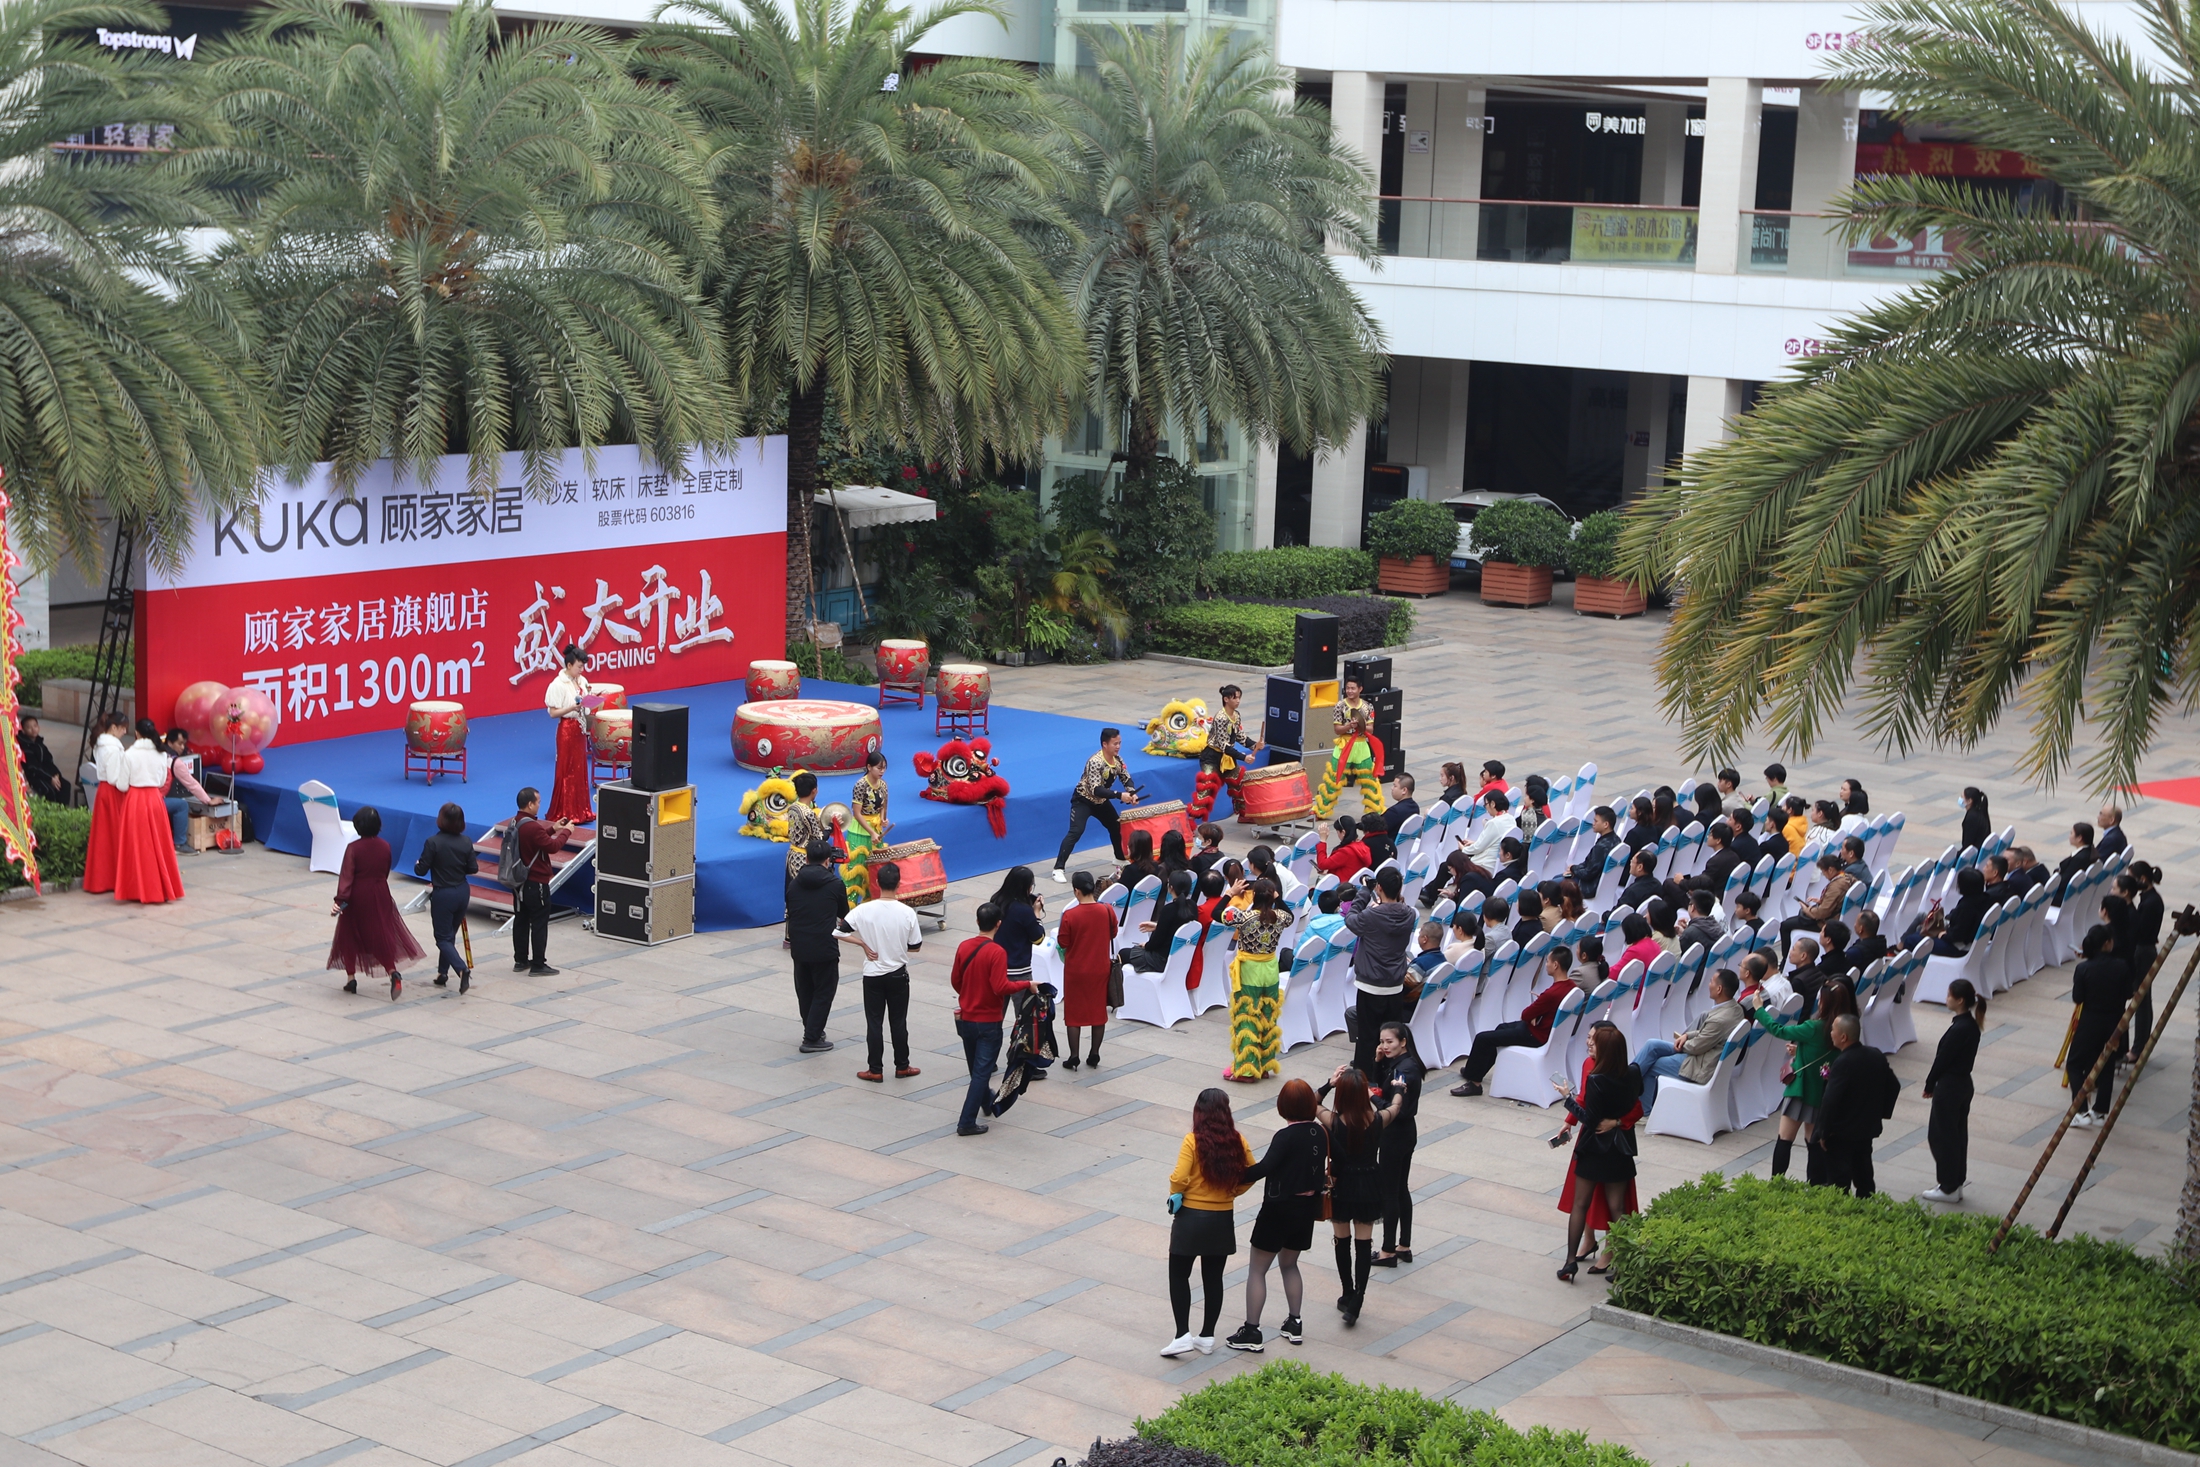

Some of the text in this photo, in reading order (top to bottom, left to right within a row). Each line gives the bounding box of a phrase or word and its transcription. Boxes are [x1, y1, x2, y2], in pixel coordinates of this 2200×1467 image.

[96, 27, 172, 53] Topstrong
[547, 467, 743, 506] 沙发 软床 床垫 全屋定制
[380, 486, 524, 544] 顾家家居
[597, 504, 696, 528] 股票代码 603816
[243, 587, 490, 656] 顾家家居旗舰店
[508, 564, 735, 686] 盛大开业
[584, 646, 656, 673] OPENING
